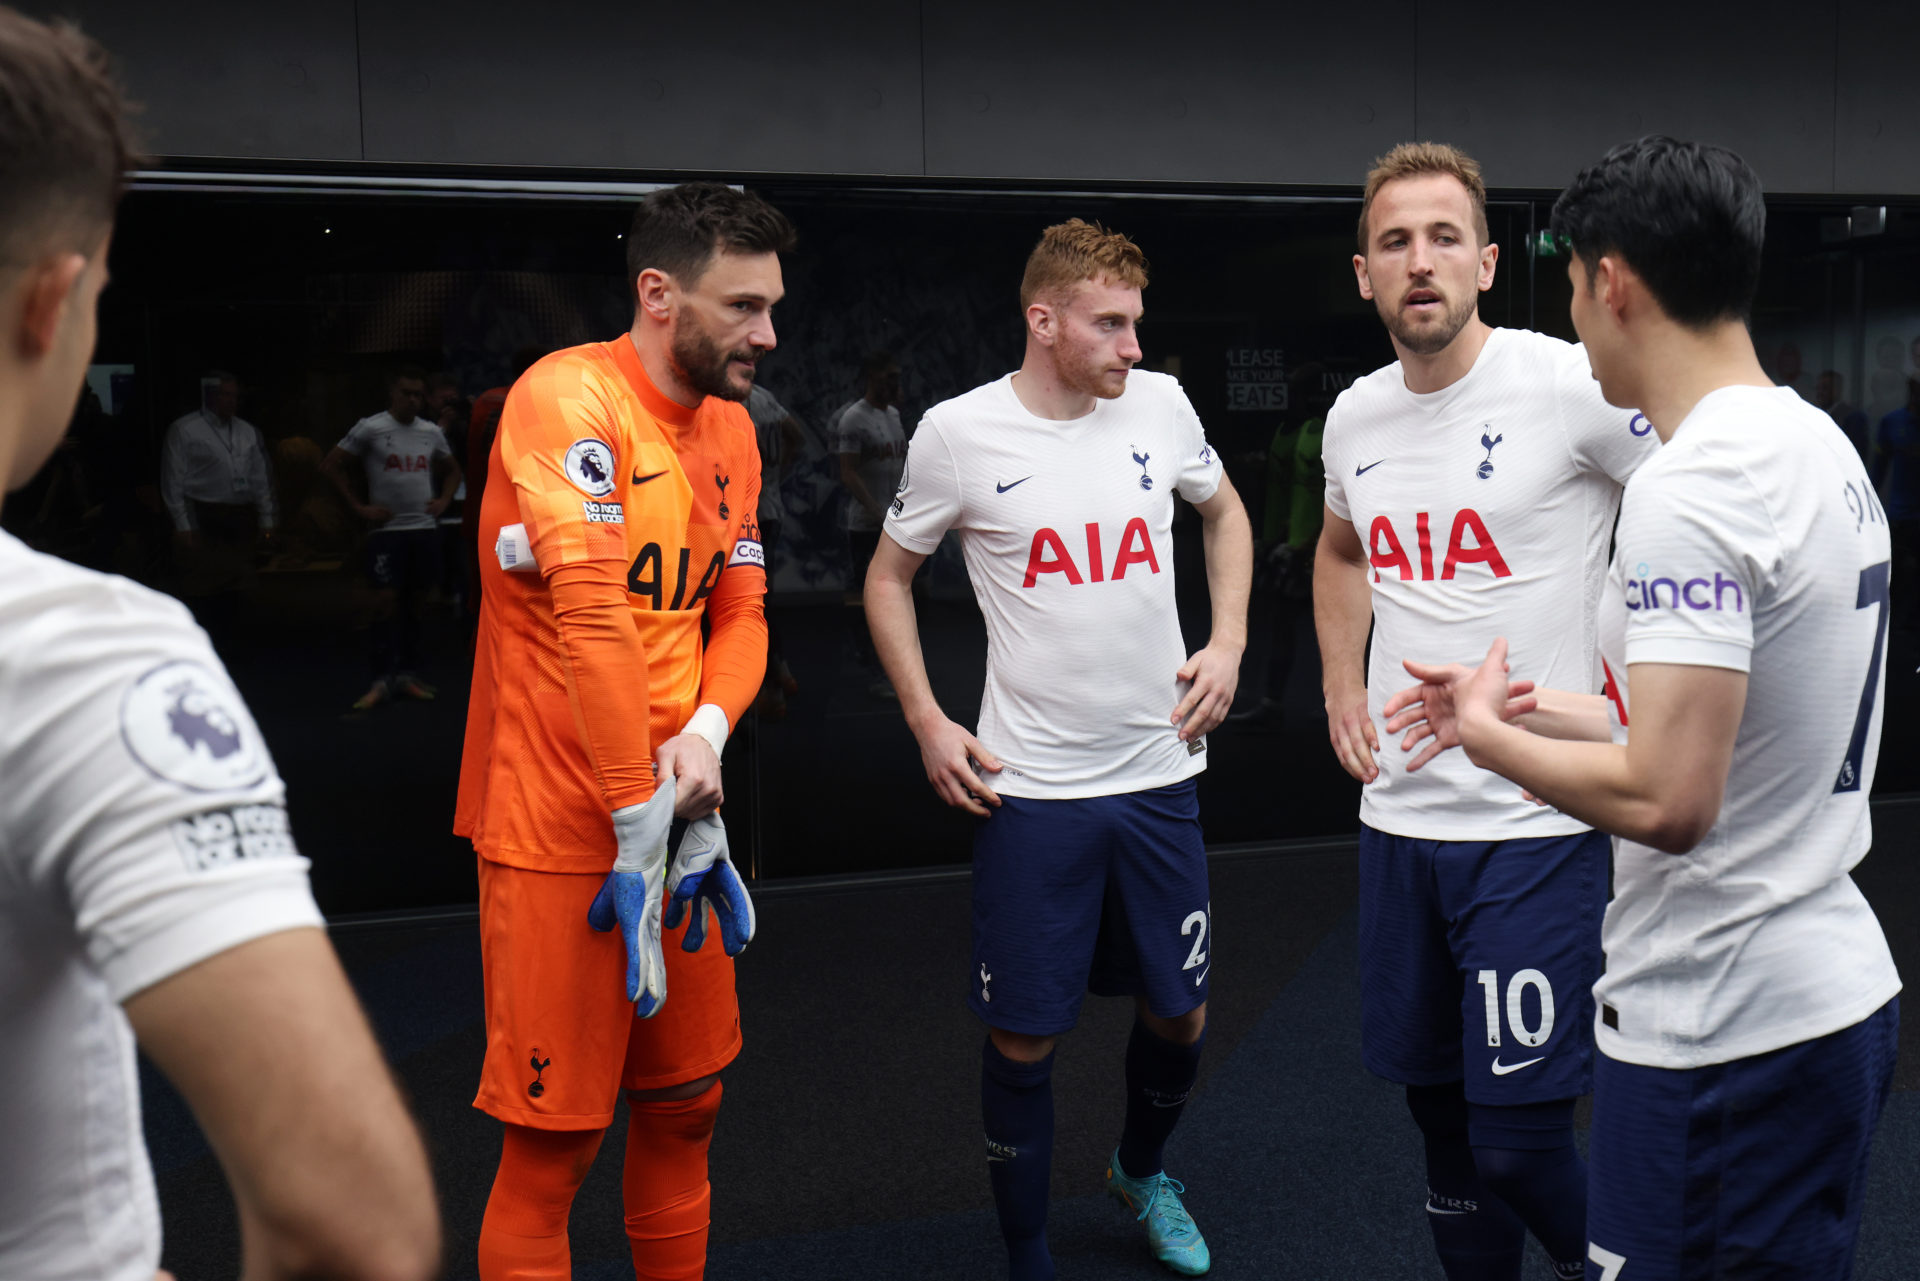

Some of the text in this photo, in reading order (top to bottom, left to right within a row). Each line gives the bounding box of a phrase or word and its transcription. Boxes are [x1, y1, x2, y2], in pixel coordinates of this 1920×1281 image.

[1227, 349, 1284, 367] LEASE
[1251, 370, 1284, 382] YOUR
[1228, 385, 1285, 407] EATS
[627, 542, 726, 611] AIA
[1022, 517, 1161, 588] AIA
[1369, 508, 1513, 584] AIA
[1625, 562, 1744, 613] cinch
[1832, 560, 1891, 795] 7
[1181, 903, 1210, 970] 2
[1478, 968, 1555, 1048] 10
[1587, 1241, 1627, 1281] 7
